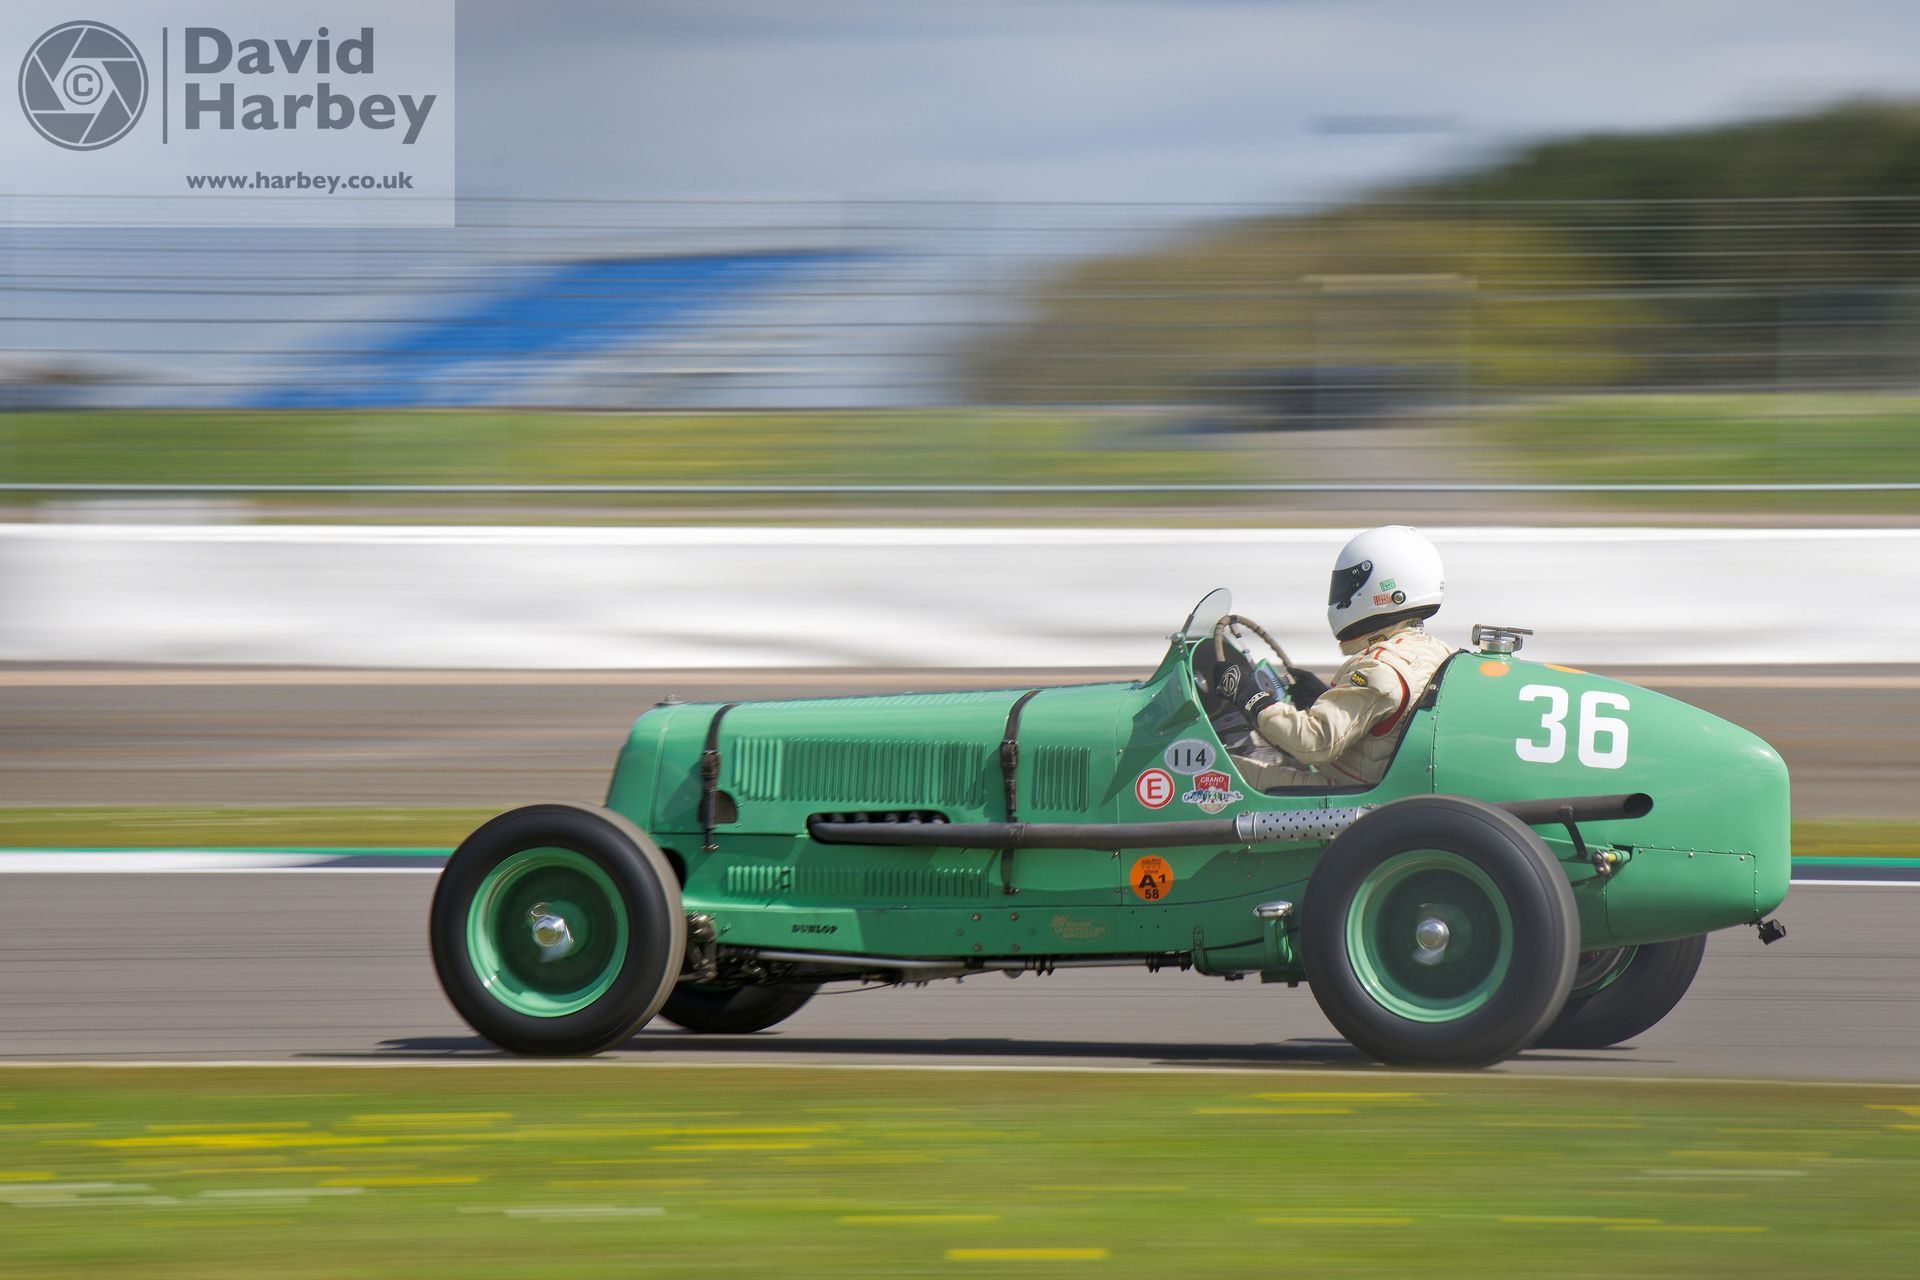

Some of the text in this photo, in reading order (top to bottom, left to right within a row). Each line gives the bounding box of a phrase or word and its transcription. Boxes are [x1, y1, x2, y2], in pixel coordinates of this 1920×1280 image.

[1515, 684, 1631, 770] 36
[1174, 748, 1207, 767] 114
[1146, 778, 1163, 800] E
[1145, 888, 1159, 900] 58
[791, 924, 838, 934] DUNLOP
